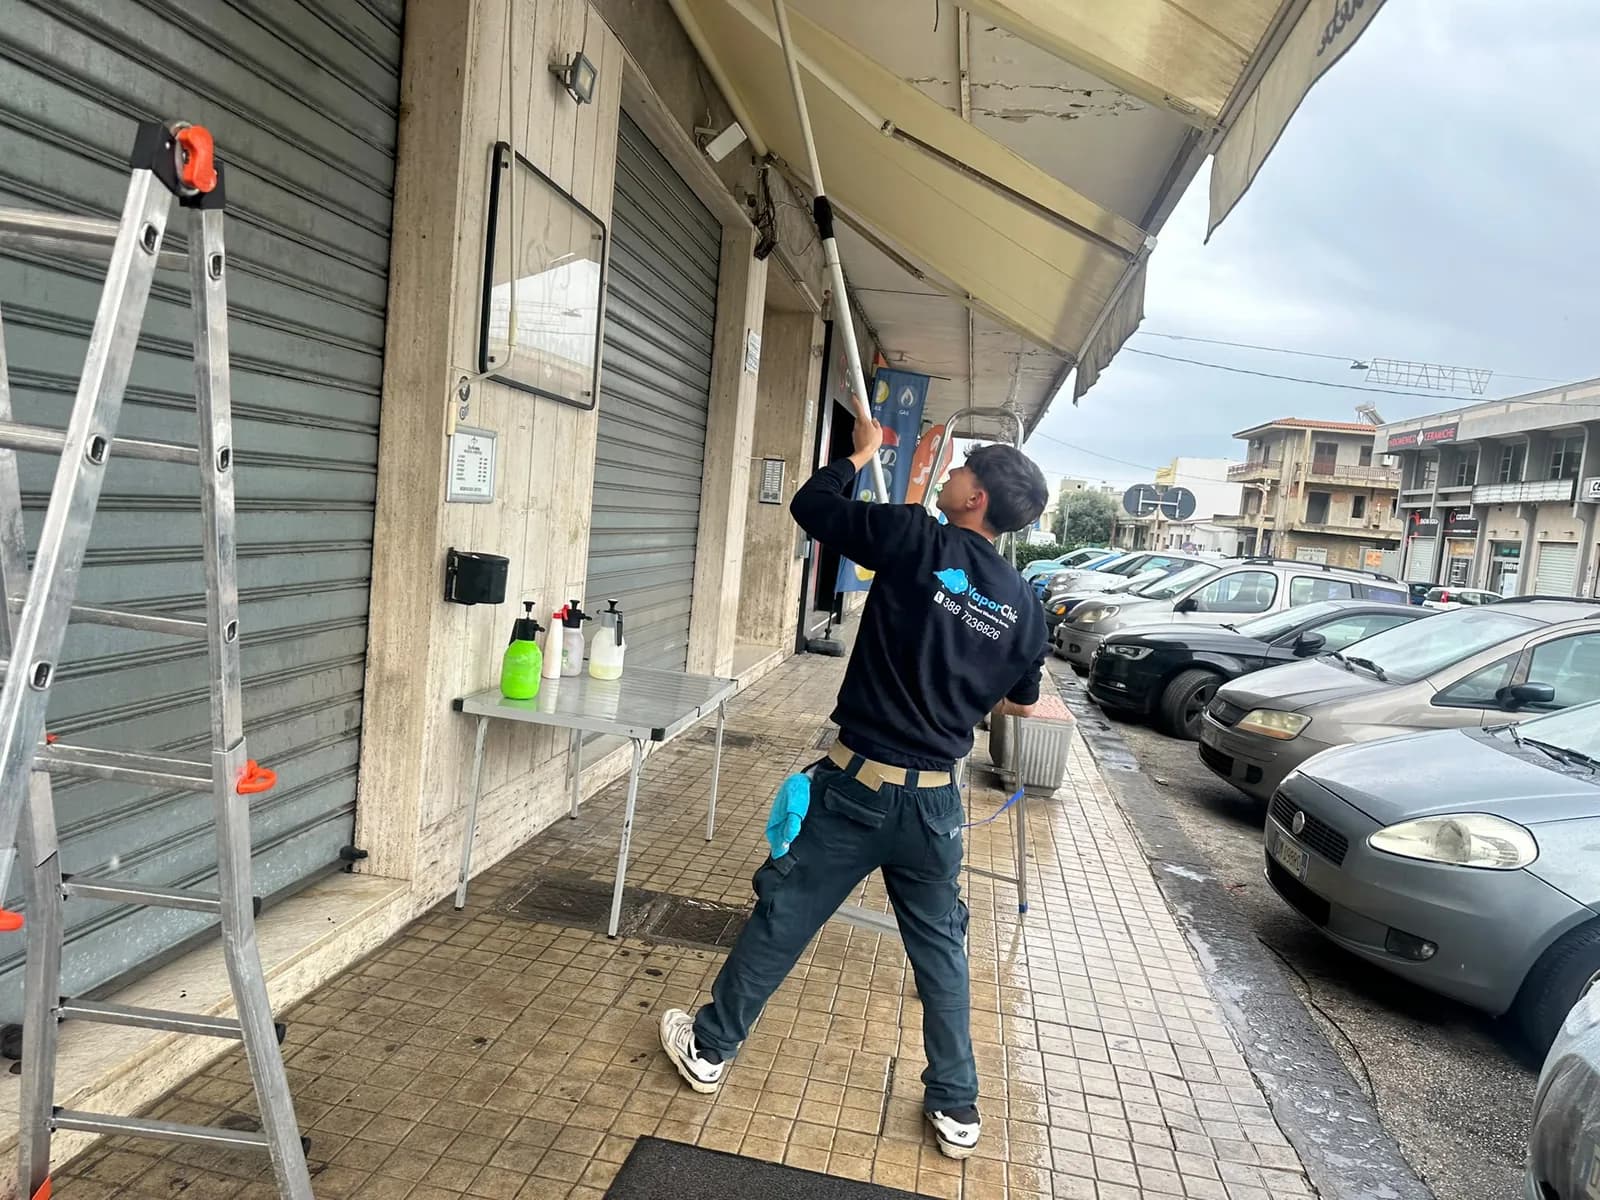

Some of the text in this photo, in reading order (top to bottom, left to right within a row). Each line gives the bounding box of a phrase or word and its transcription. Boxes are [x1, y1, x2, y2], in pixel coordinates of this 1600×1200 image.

[943, 597, 961, 615] 388
[961, 610, 1001, 640] 7236826
[968, 584, 1018, 623] VaporChic
